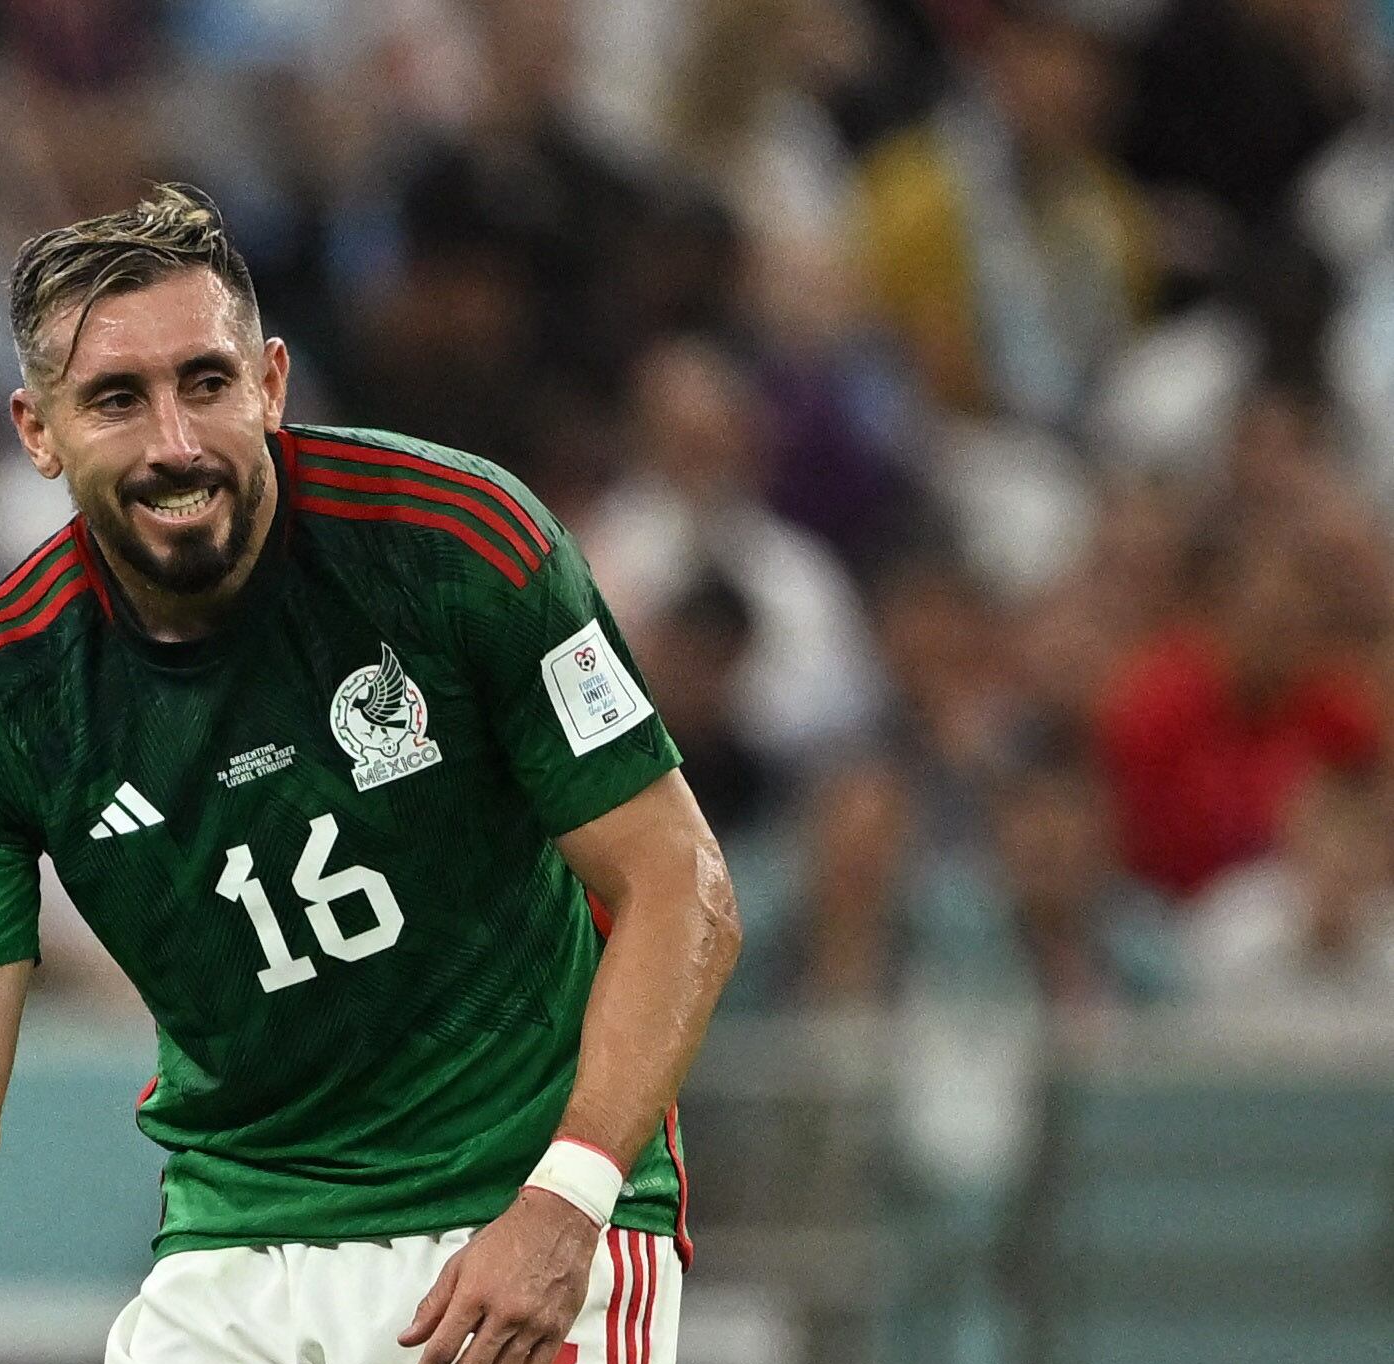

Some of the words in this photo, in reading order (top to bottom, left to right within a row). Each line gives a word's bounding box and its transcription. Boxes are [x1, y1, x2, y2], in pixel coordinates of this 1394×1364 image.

[228, 753, 273, 777] NOVEMBER
[274, 744, 296, 761] 2022
[229, 743, 276, 766] ARGENTINA
[355, 745, 438, 788] MÉXICO
[225, 771, 256, 789] LUSAIL
[255, 756, 294, 778] STADIUM
[215, 813, 405, 993] 16
